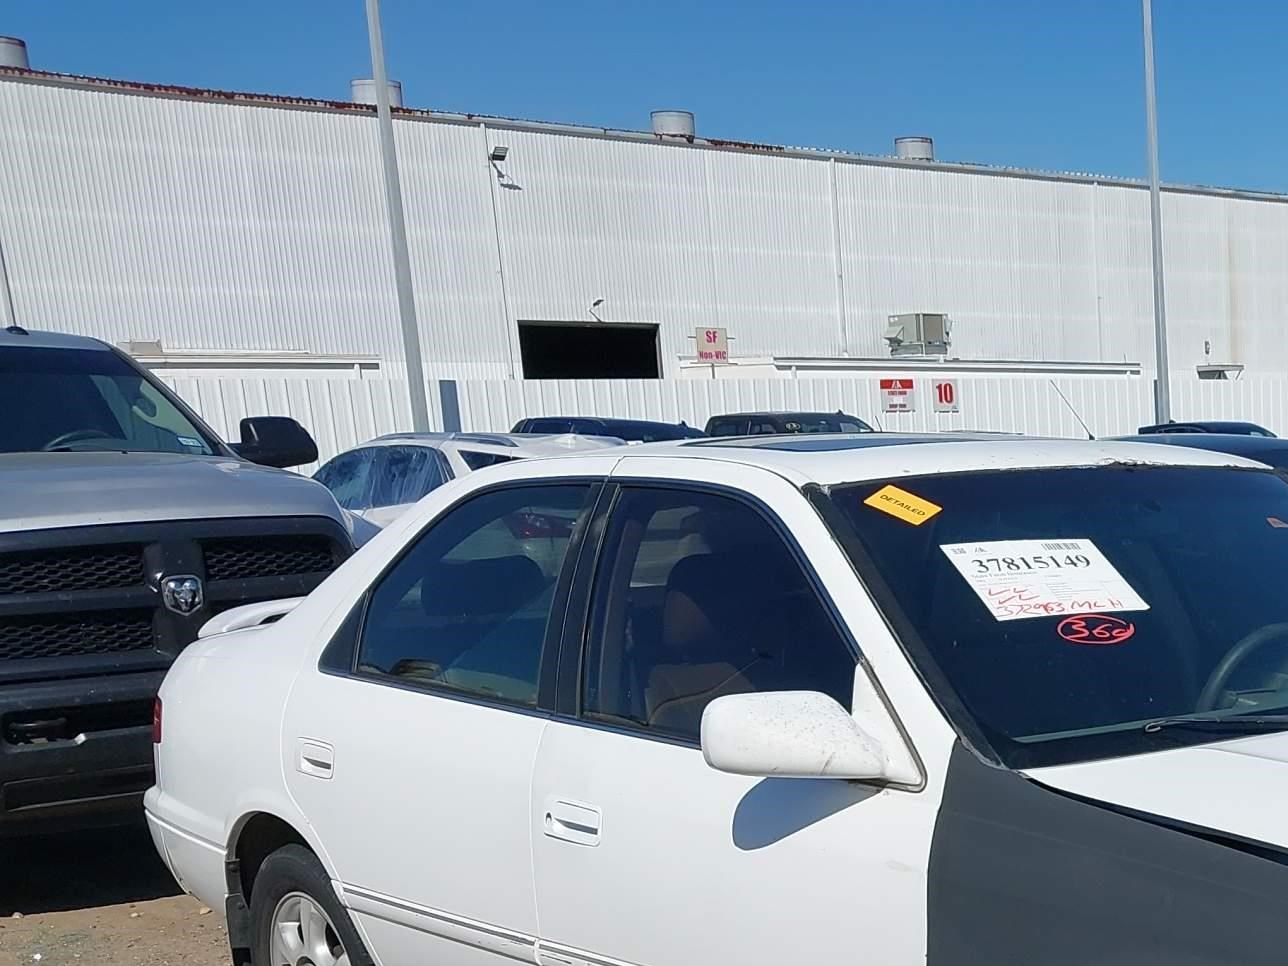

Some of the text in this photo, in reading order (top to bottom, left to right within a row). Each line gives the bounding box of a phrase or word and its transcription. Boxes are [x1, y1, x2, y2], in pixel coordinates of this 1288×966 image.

[705, 330, 718, 344] SF
[936, 382, 954, 404] 10
[879, 494, 927, 517] DETAILED
[970, 554, 1091, 573] 37815149
